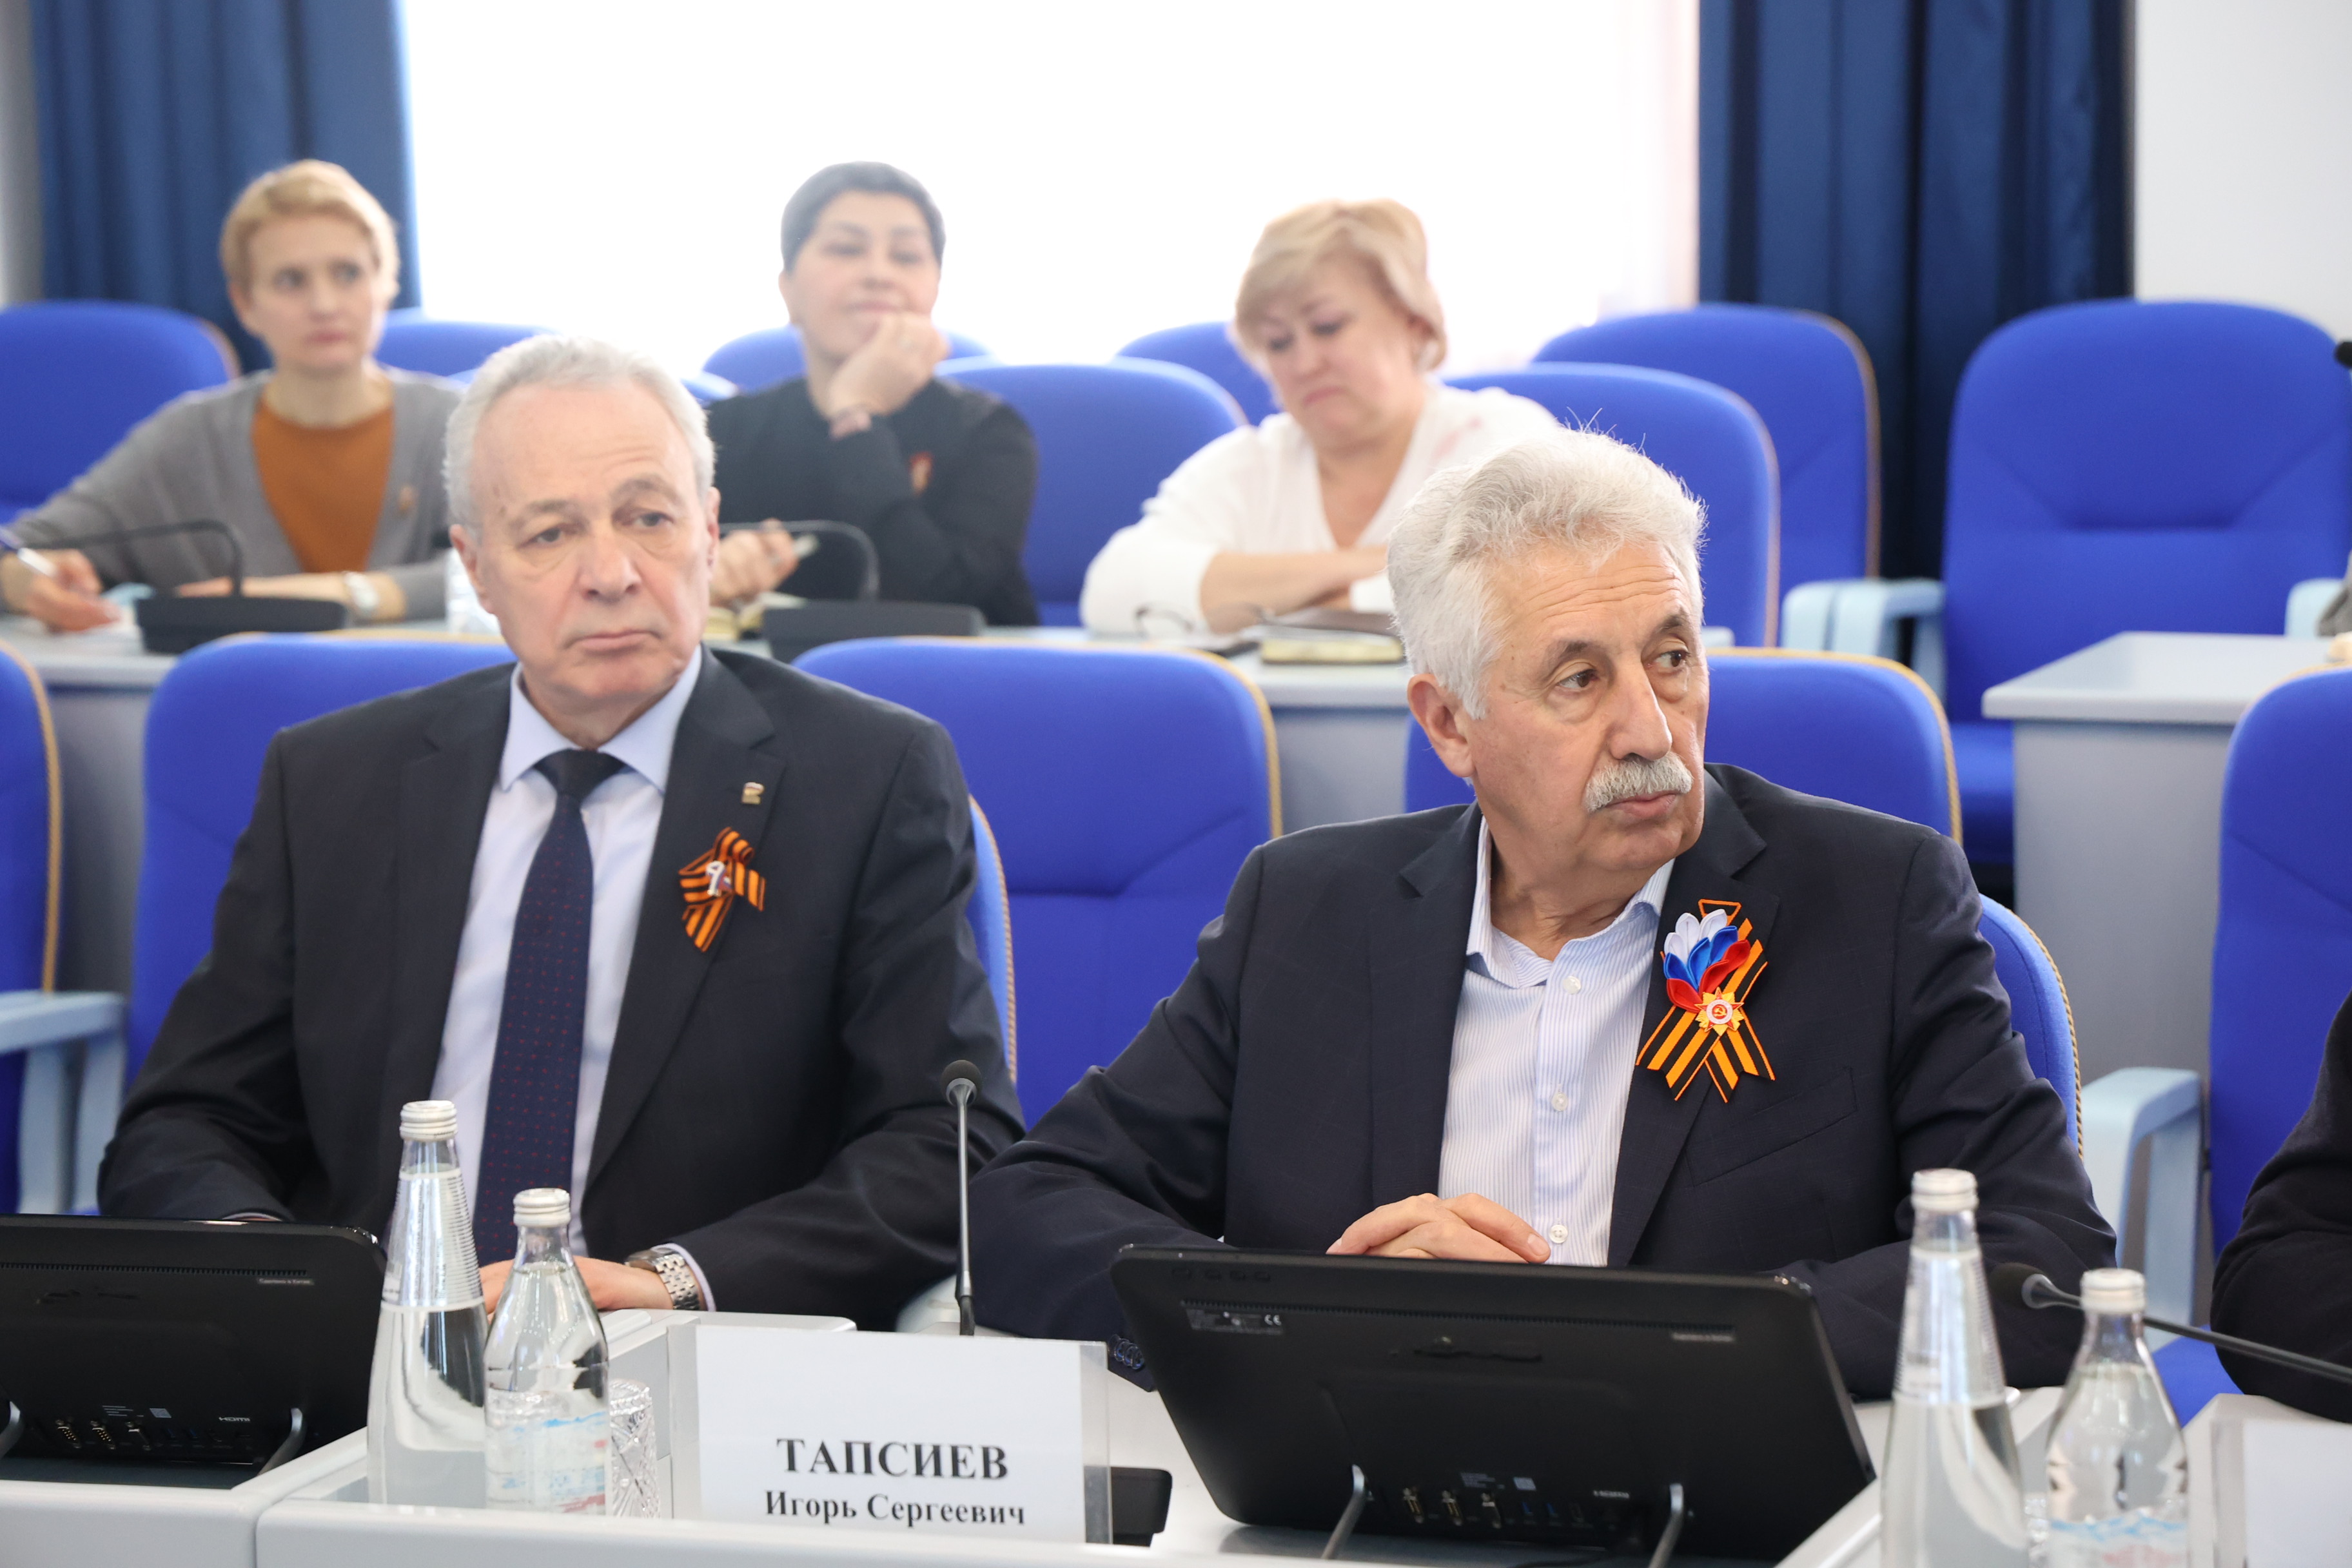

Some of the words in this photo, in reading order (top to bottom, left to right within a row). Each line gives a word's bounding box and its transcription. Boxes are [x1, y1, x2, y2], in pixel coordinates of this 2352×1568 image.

[776, 1438, 1008, 1480] ТАПСИЕВ
[765, 1491, 858, 1525] Игорь
[867, 1494, 1025, 1528] Сергеевич
